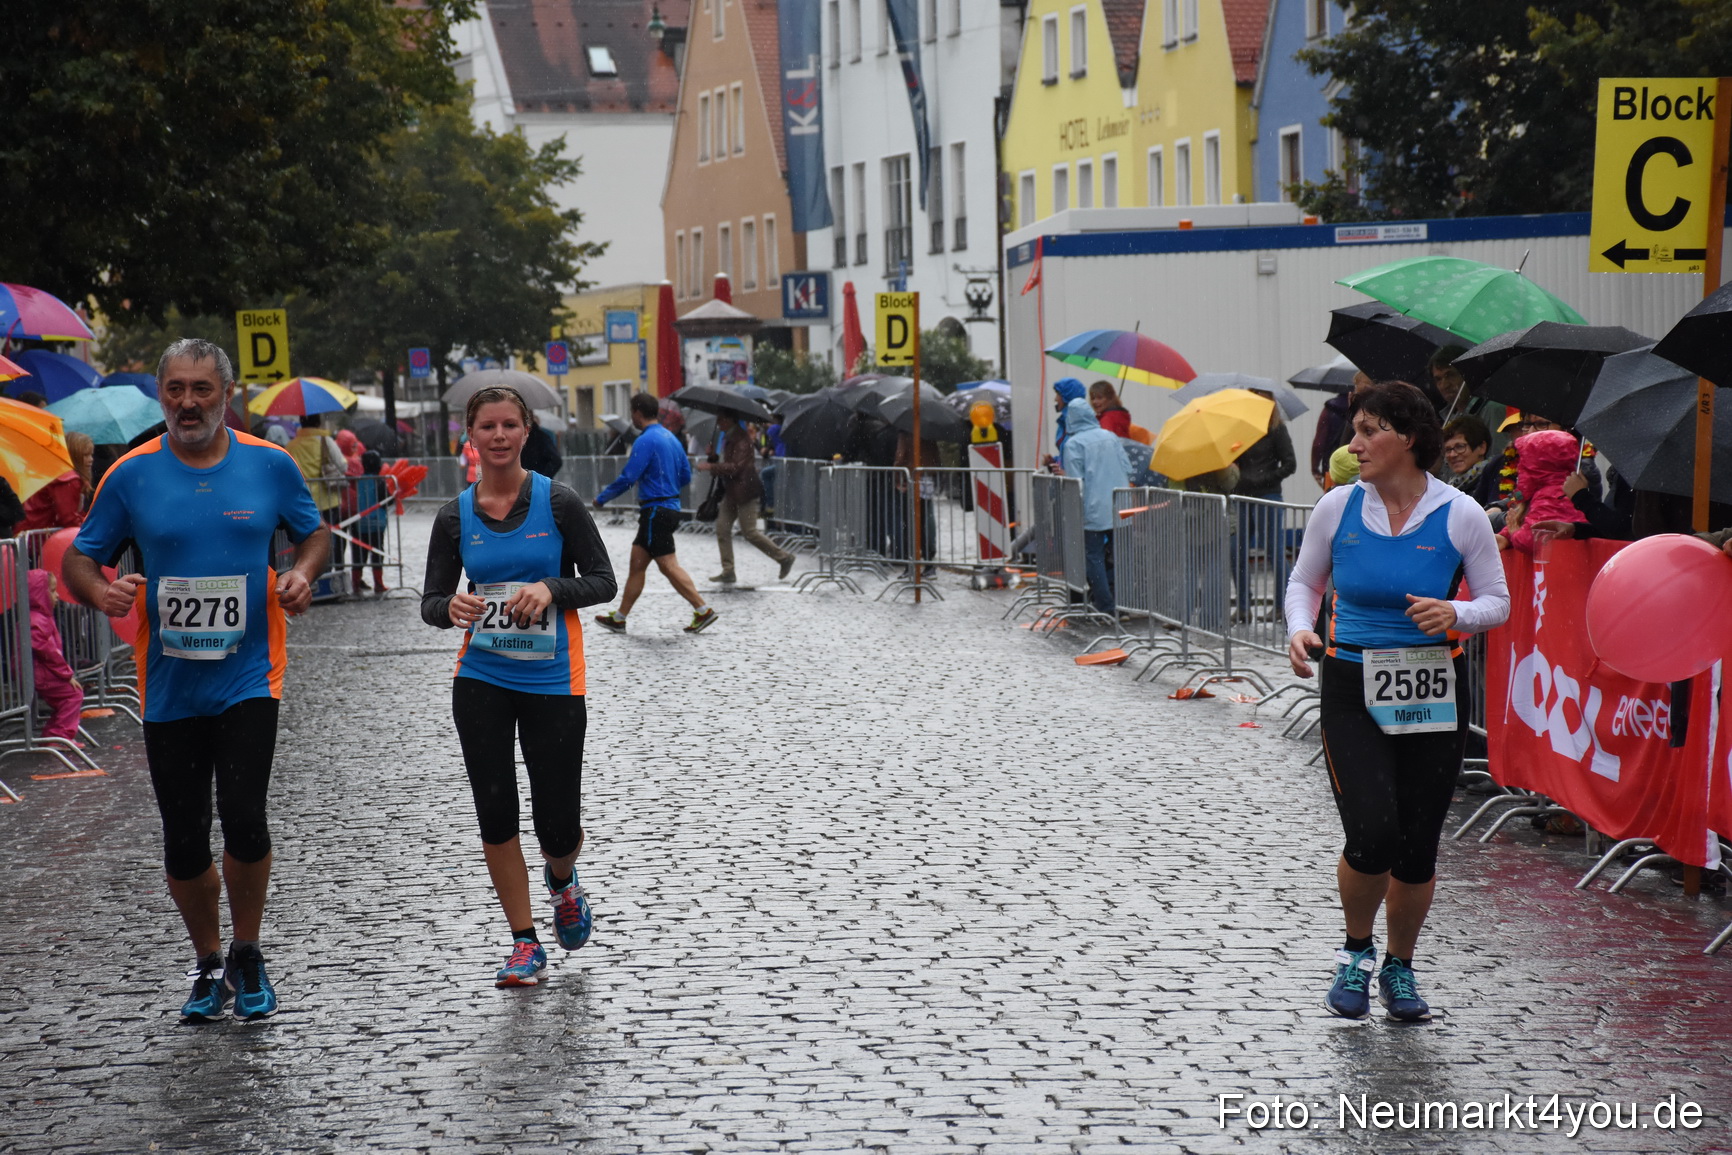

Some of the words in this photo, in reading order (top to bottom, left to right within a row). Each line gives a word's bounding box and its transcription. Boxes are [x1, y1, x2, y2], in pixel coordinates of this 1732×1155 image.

[785, 53, 820, 135] K&L
[1613, 86, 1715, 121] Block
[1059, 118, 1090, 151] HOTEL
[1625, 136, 1694, 232] C
[880, 294, 914, 309] Block
[242, 312, 280, 327] Block
[887, 314, 909, 349] D
[250, 332, 276, 368] D
[549, 364, 567, 372] TAXI
[195, 579, 239, 590] BOCK
[166, 596, 240, 628] 2278
[181, 635, 225, 648] Werner
[491, 636, 534, 650] Kristina
[1405, 649, 1447, 661] BOCK
[1374, 667, 1448, 702] 2585
[1394, 707, 1432, 723] Margit
